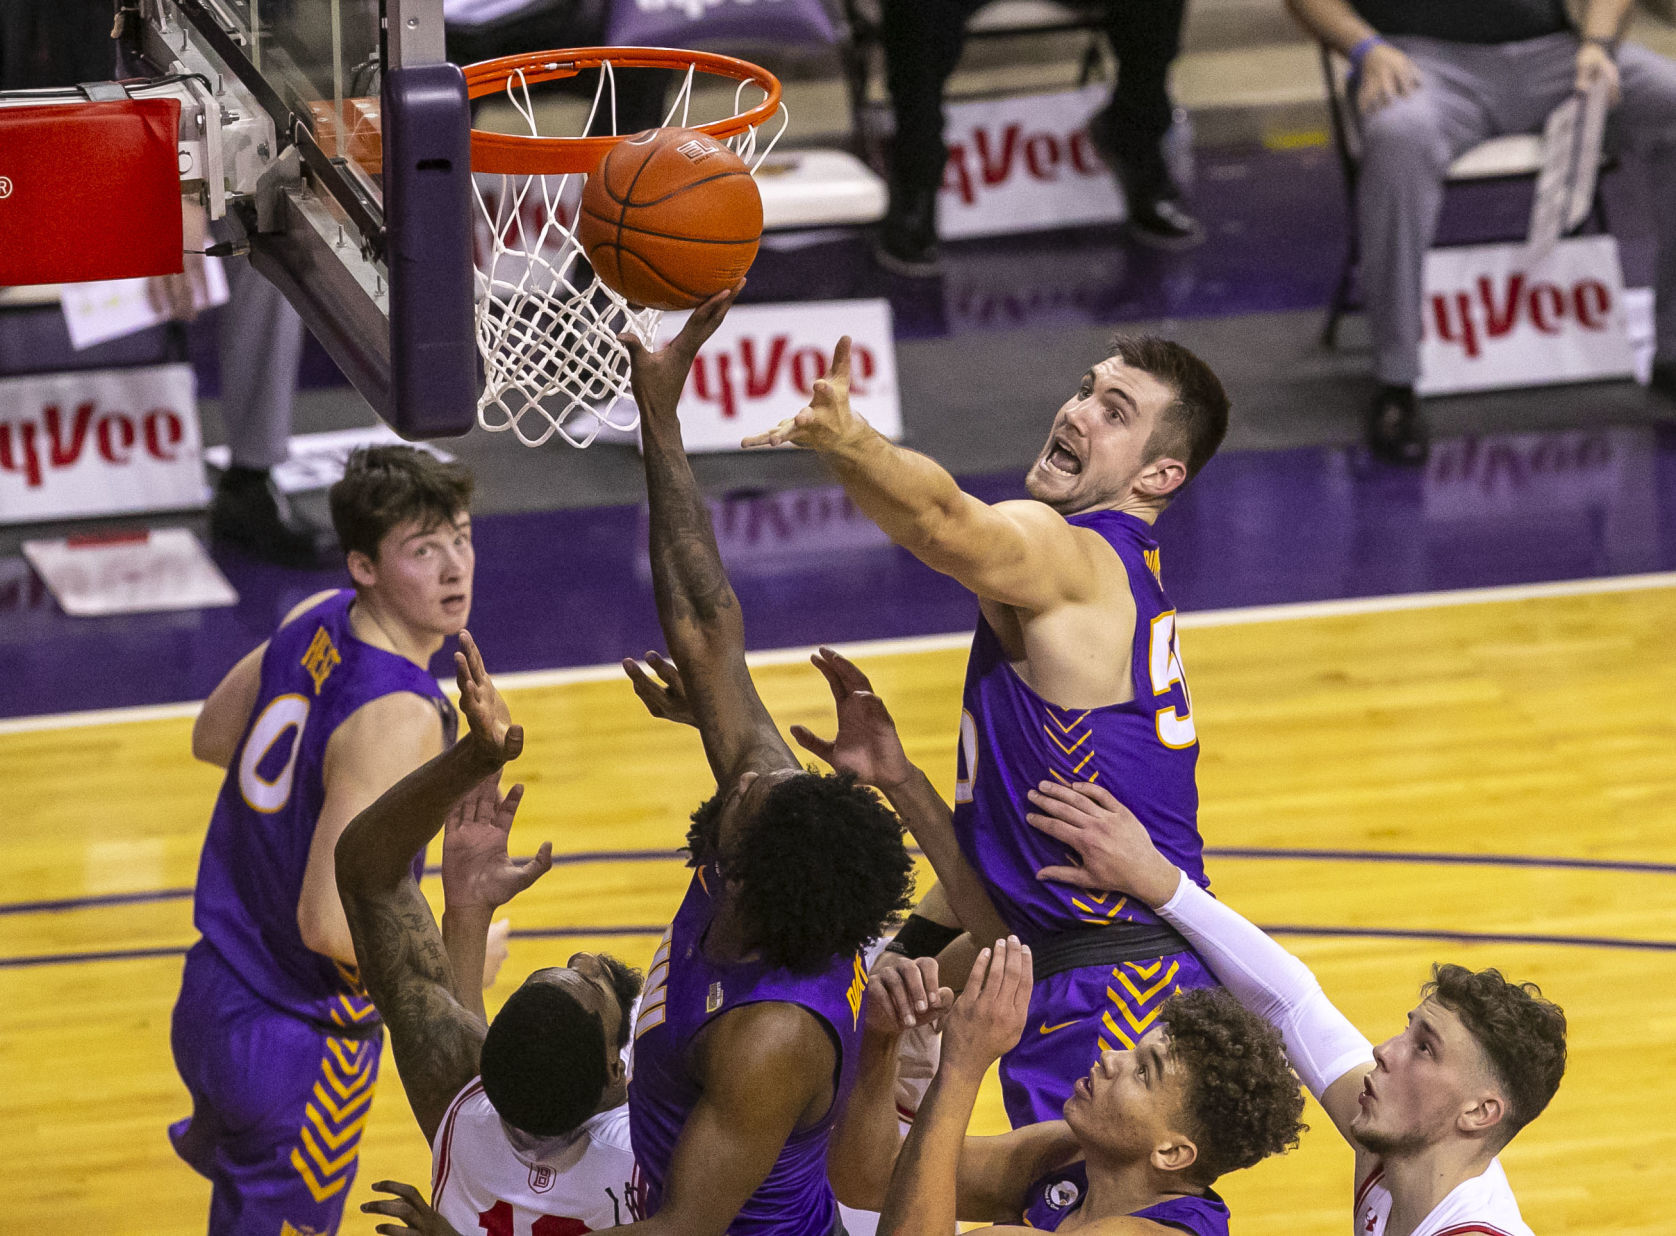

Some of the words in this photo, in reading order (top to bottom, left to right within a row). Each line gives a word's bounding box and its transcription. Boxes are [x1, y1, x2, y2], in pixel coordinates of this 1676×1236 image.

[1424, 270, 1612, 360] yVee
[681, 334, 877, 419] yVee
[1149, 608, 1197, 749] 5
[239, 692, 310, 813] 0
